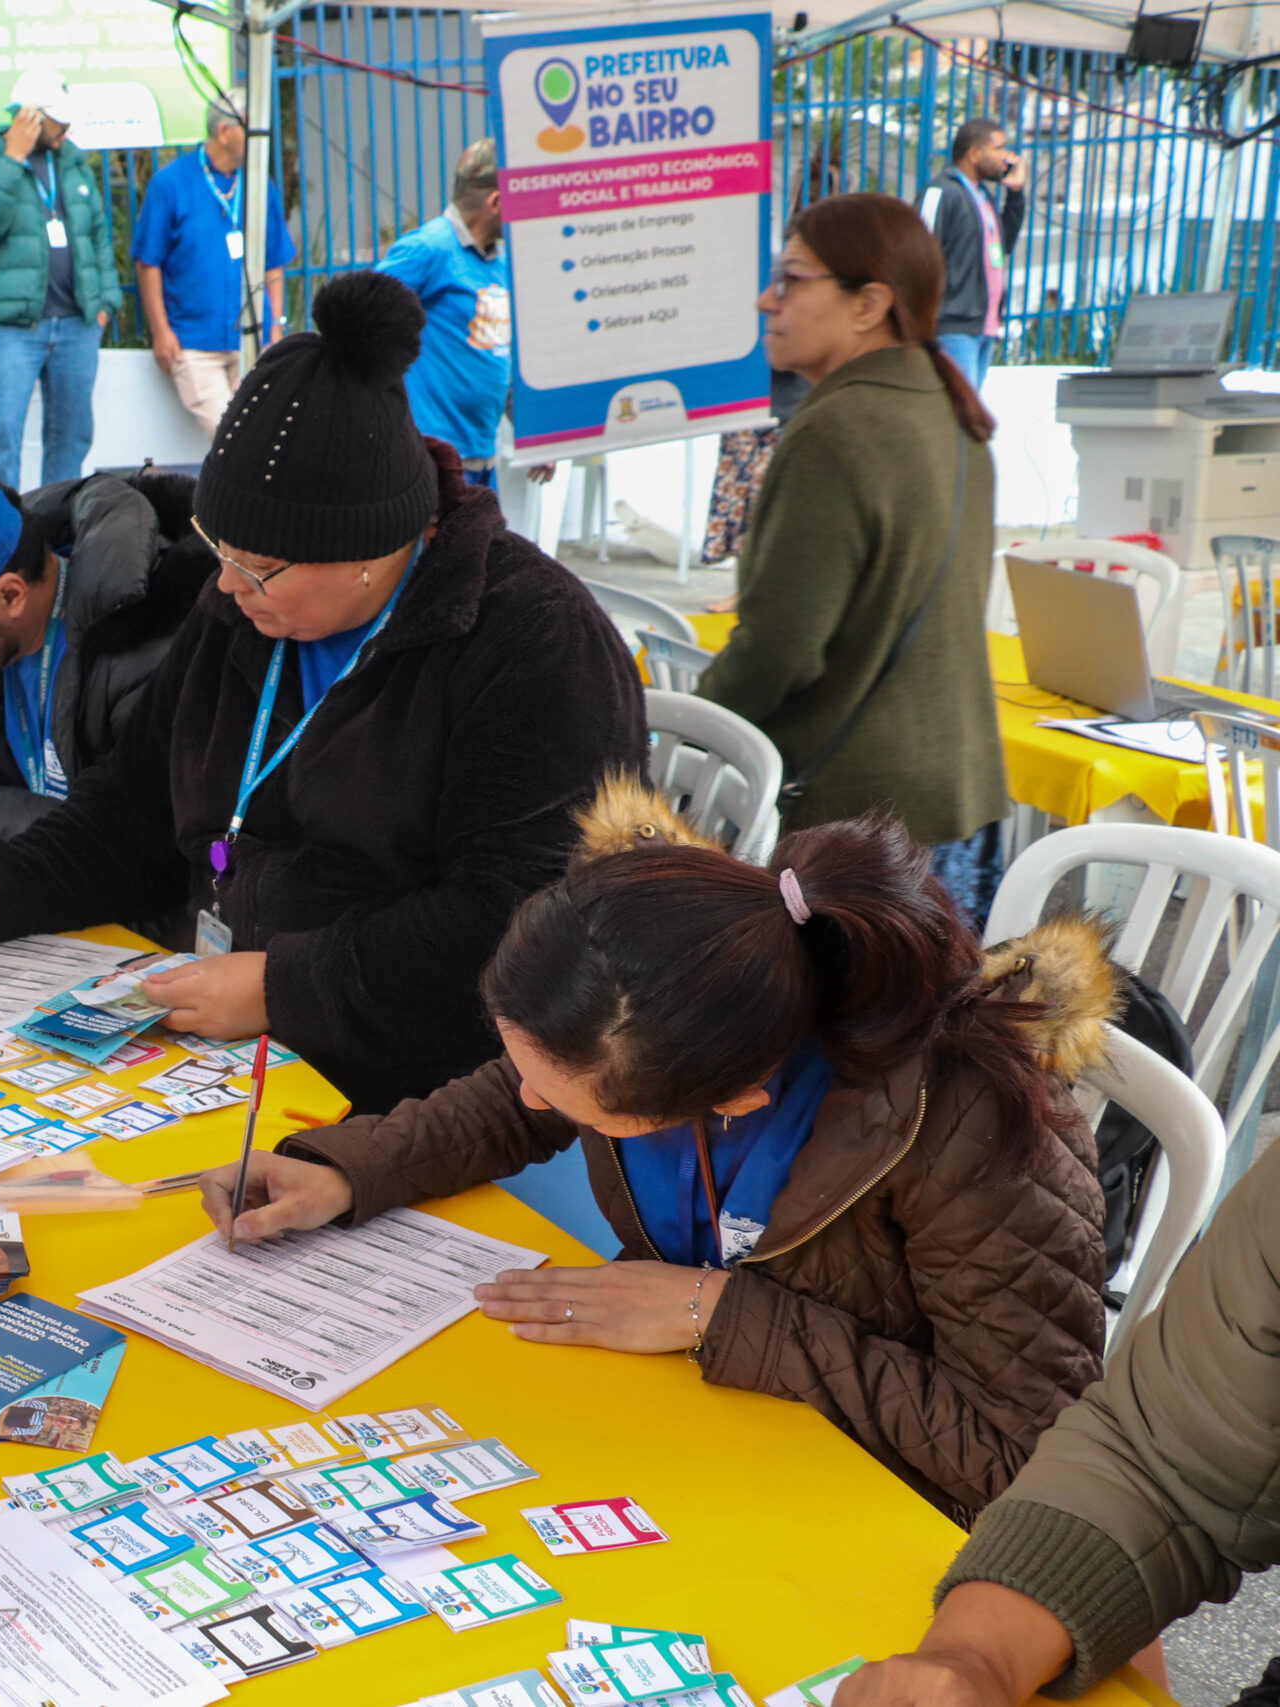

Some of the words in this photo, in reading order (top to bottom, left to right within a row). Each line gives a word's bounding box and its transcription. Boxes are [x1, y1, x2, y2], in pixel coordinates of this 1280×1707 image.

[585, 44, 730, 80] PREFEITURA
[587, 83, 624, 110] NO
[634, 77, 678, 105] SEU
[588, 105, 715, 148] BAIRRO
[508, 163, 660, 193] DESENVOLVIMENTO
[662, 151, 760, 176] ECONÔMICO,
[559, 188, 618, 208] SOCIAL
[620, 186, 630, 200] E
[633, 177, 714, 199] TRABALHO
[579, 222, 618, 236] Vagas
[621, 218, 635, 231] de
[639, 212, 696, 229] Emprego
[581, 248, 649, 268] Orientação
[652, 243, 695, 258] Procon
[591, 279, 657, 299] Orientação
[660, 273, 689, 289] INSS
[604, 314, 645, 329] Sebrae
[648, 307, 679, 323] AQUI
[245, 761, 256, 784] CIDADE
[251, 752, 258, 760] DE
[104, 1295, 153, 1319] CADASTRO
[113, 1292, 136, 1303] 2026
[2, 1300, 63, 1327] SECRETARIA
[62, 1323, 80, 1334] DE
[153, 1315, 167, 1323] DE
[167, 1322, 195, 1337] FICHA
[47, 1335, 86, 1356] SOCIAL
[5, 1354, 25, 1366] Para
[24, 1362, 44, 1374] você
[246, 1360, 289, 1381] PREFEITURA
[261, 1357, 300, 1376] BAIRRO
[12, 1376, 29, 1386] tem
[190, 1453, 216, 1472] DIGITAL
[237, 1497, 270, 1524] CULTURA
[100, 1527, 115, 1537] DE
[584, 1515, 606, 1537] FUNDO
[596, 1513, 617, 1536] SOCIAL
[111, 1525, 152, 1554] EMPREGO
[115, 1537, 140, 1557] VAGAS
[283, 1541, 315, 1565] PROCON
[171, 1570, 214, 1600] AMBIENTE
[476, 1568, 493, 1582] PCD
[172, 1581, 194, 1598] MEIO
[474, 1575, 506, 1603] CARTEIRA
[344, 1588, 375, 1615] SEBRAE
[229, 1629, 262, 1656] OUVIDORIA
[242, 1632, 264, 1649] GERAL
[623, 1653, 652, 1687] CADASTRO
[636, 1658, 656, 1678] ÚNICO
